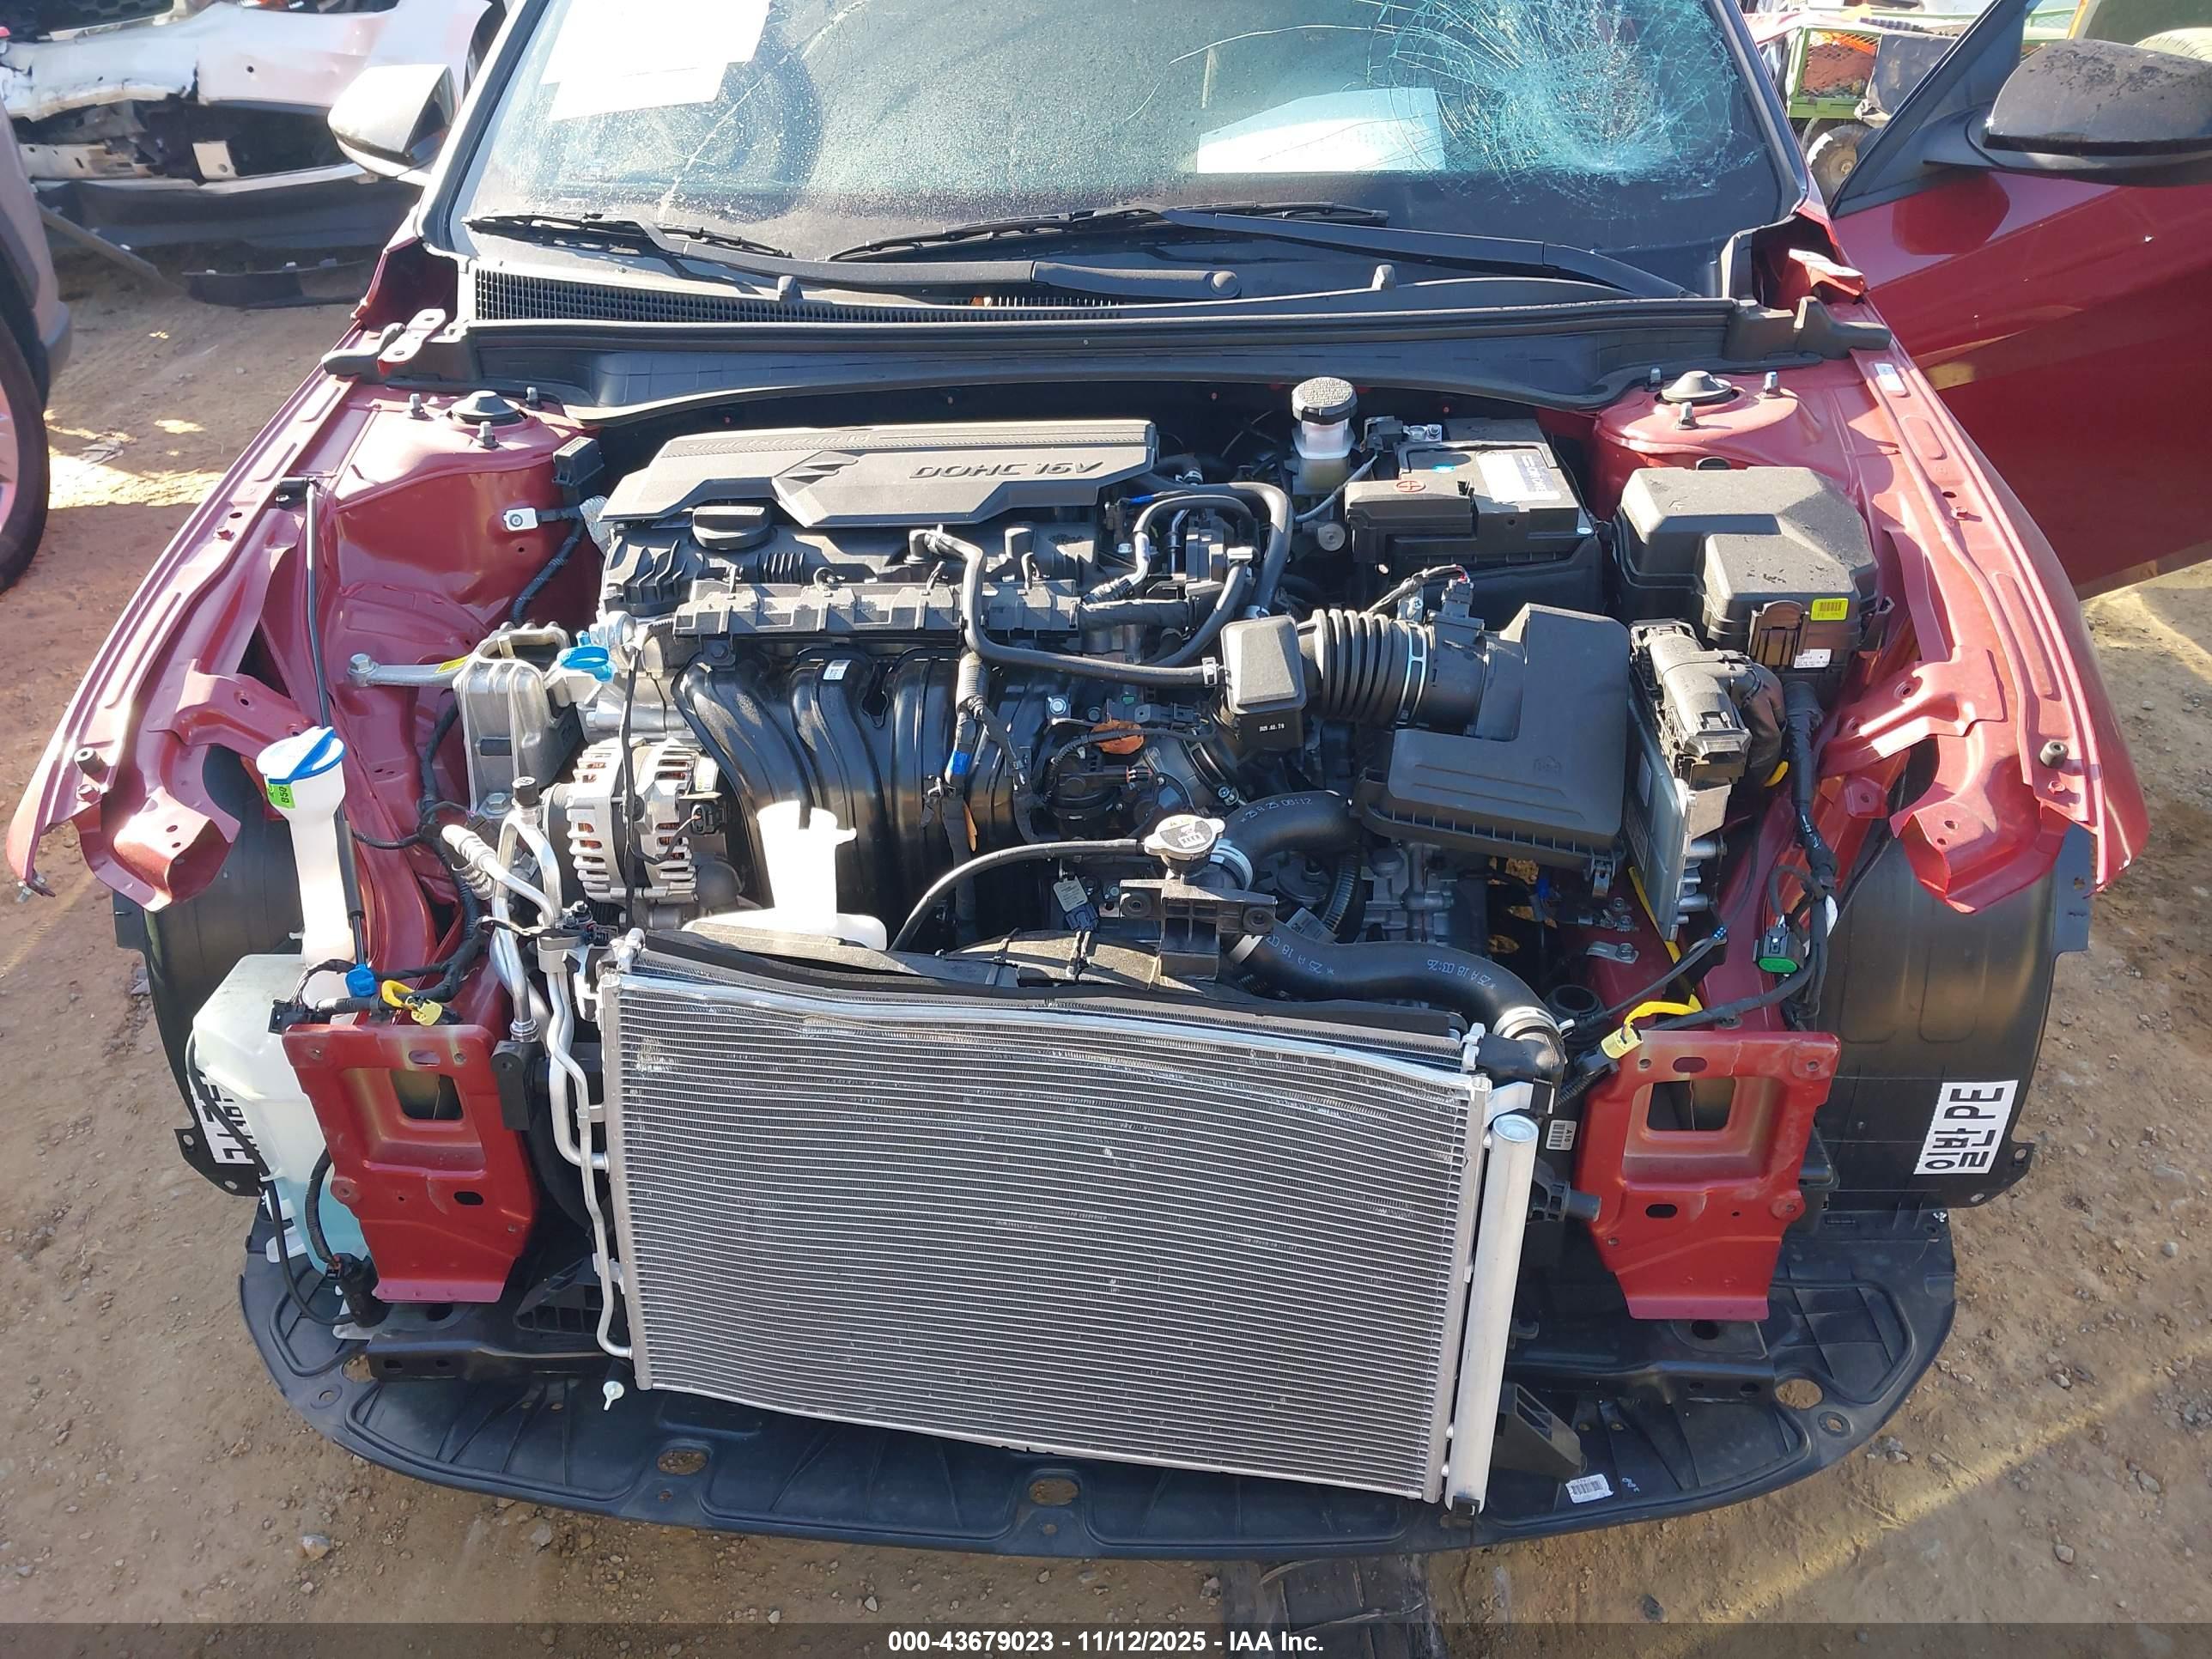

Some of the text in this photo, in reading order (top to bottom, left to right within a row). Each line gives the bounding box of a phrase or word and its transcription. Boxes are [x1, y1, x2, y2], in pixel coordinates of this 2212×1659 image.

[908, 460, 1105, 480] DOHC 16V
[1924, 1086, 2006, 1170] 일반 PE
